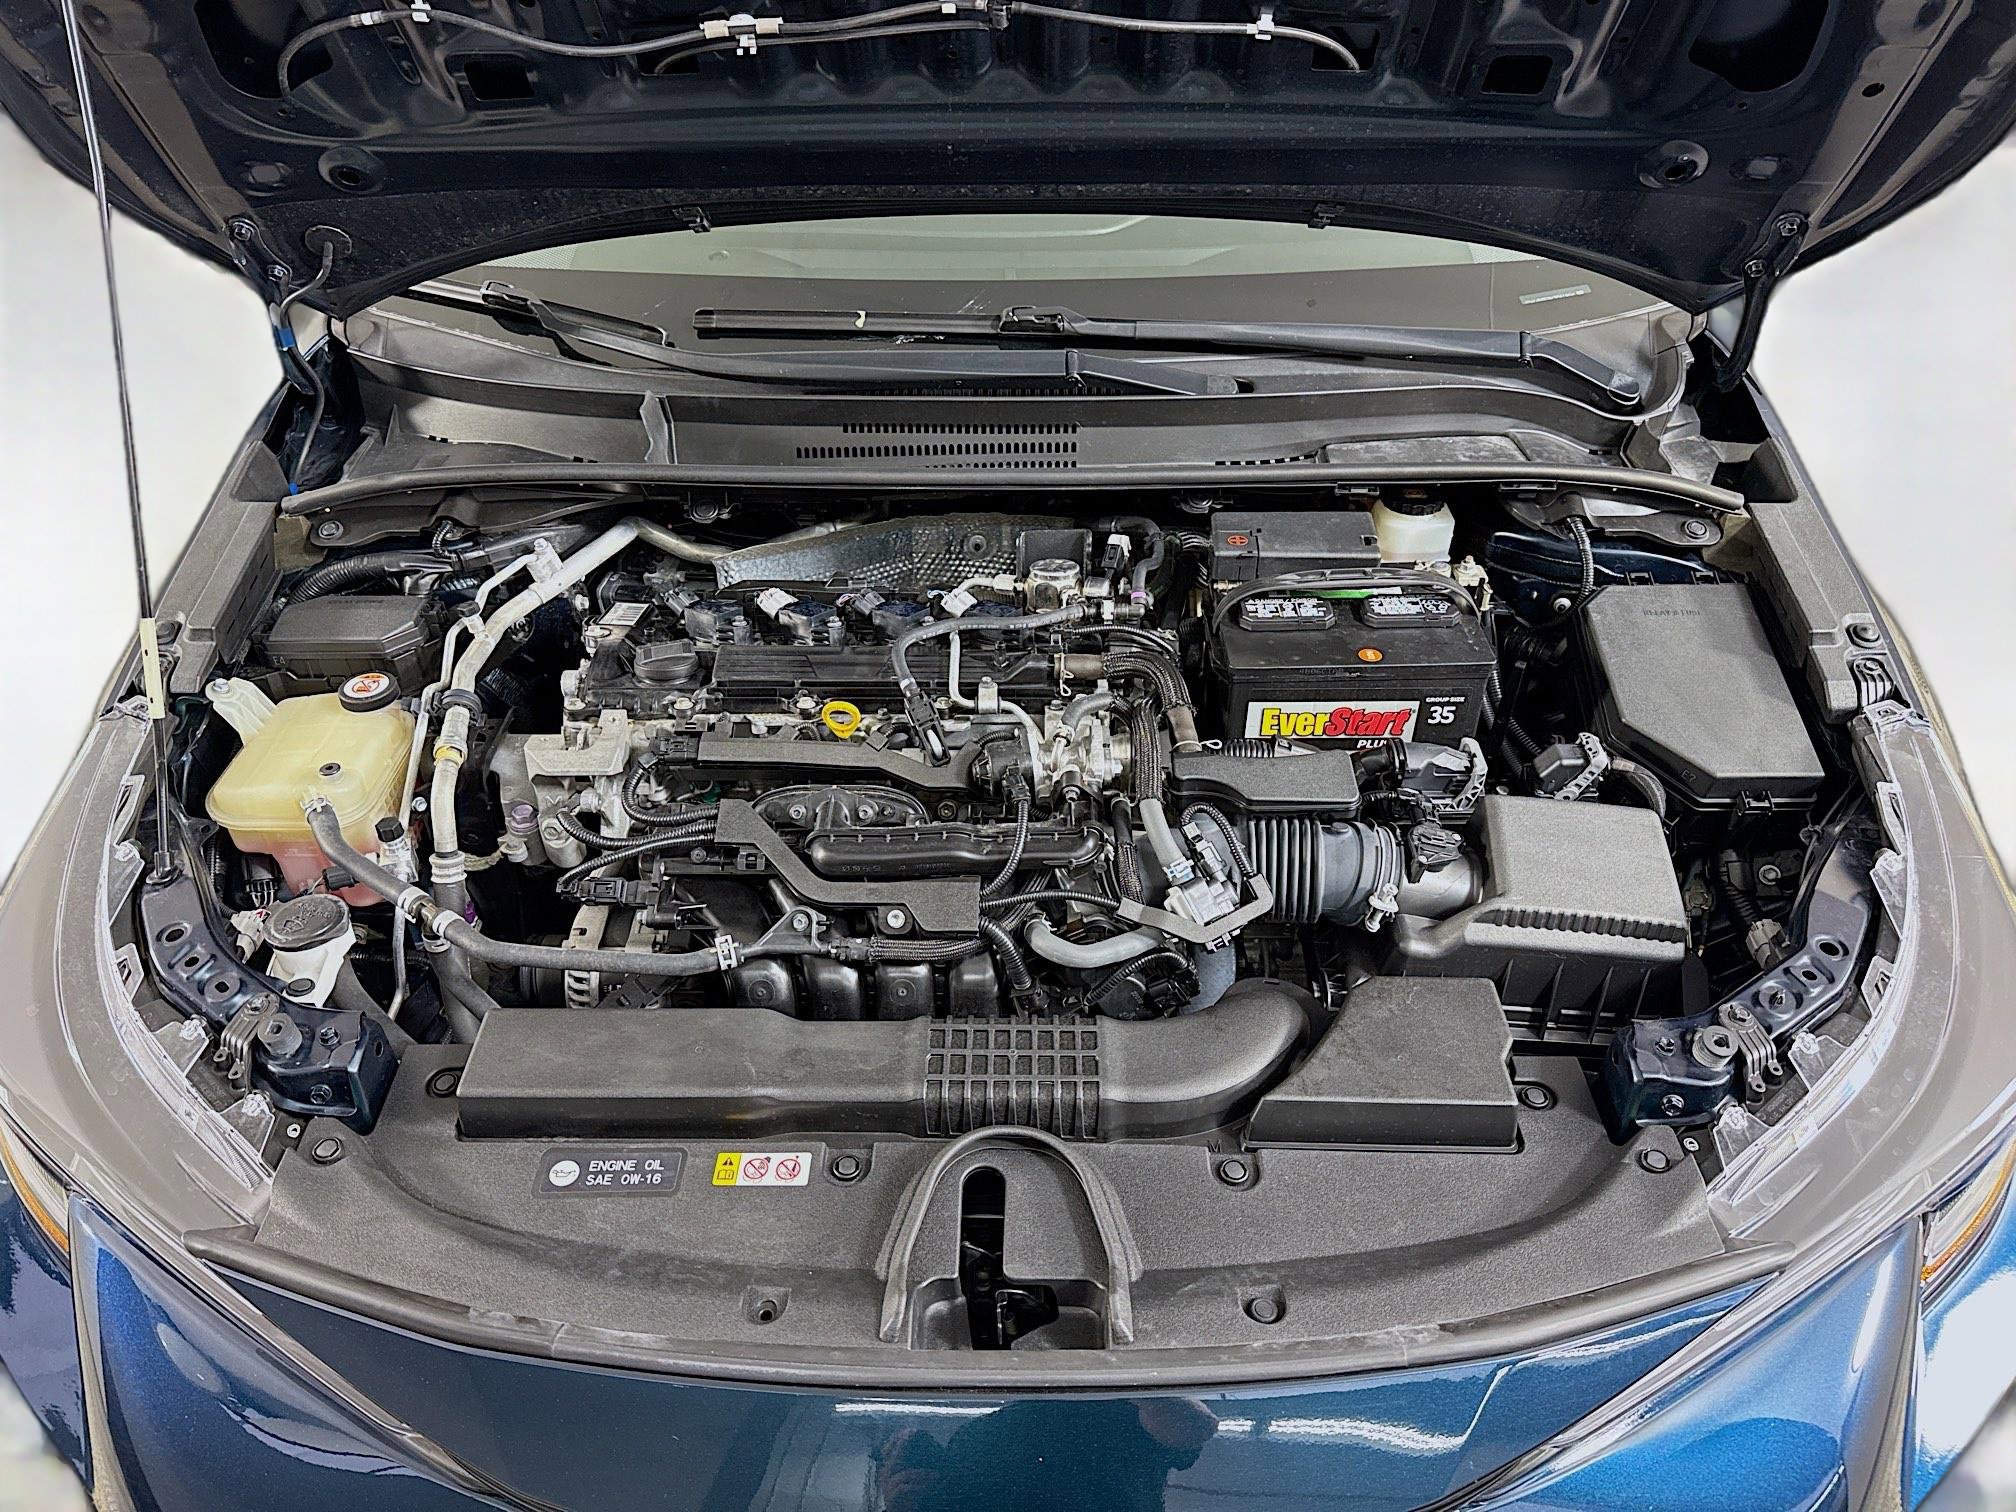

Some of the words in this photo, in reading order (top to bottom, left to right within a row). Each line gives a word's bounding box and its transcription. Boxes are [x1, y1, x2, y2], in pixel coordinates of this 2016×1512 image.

[1260, 706, 1413, 737] EverStart
[1427, 705, 1457, 724] 35
[588, 1159, 637, 1172] ENGINE
[644, 1159, 665, 1171] OIL
[585, 1173, 614, 1186] SAE
[620, 1173, 662, 1185] 0W-16
